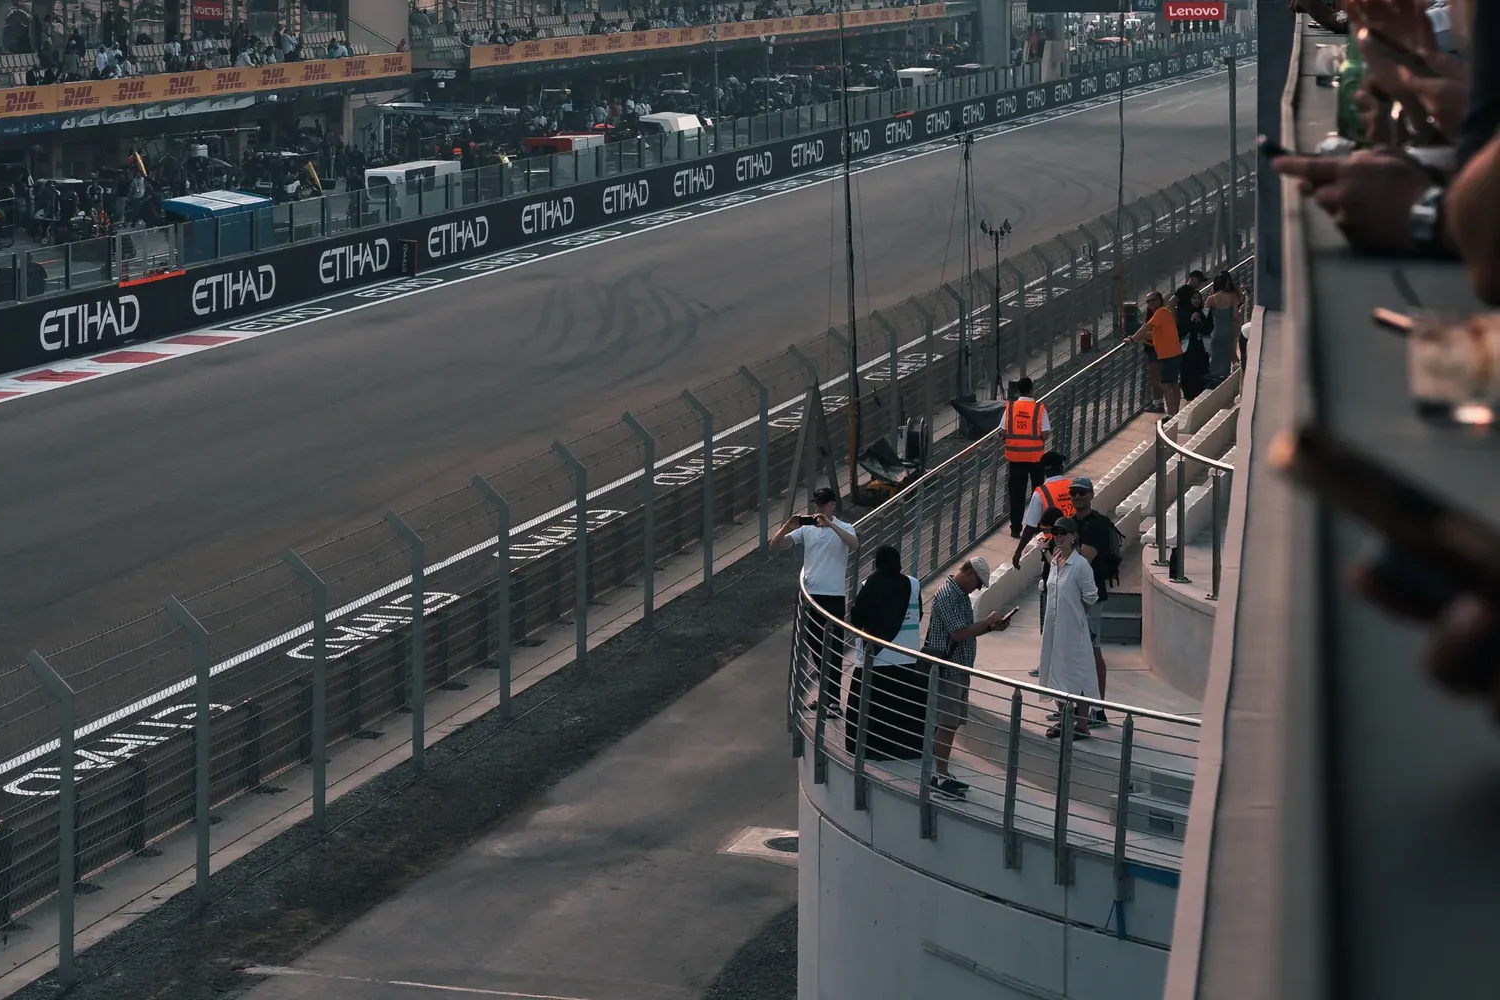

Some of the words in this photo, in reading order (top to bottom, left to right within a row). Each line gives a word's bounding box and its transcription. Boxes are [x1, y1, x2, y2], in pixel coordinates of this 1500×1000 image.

[1169, 5, 1219, 16] Lenovo
[305, 64, 327, 81] DHL
[346, 60, 367, 77] DHL
[384, 56, 403, 73] DHL
[432, 69, 457, 79] YAS
[170, 76, 197, 95] DHL
[218, 72, 242, 90] DHL
[263, 68, 285, 85] DHL
[1081, 76, 1098, 96] ETIHAD
[1105, 71, 1120, 90] ETIHAD
[64, 87, 95, 106] DHL
[119, 81, 145, 100] DHL
[1026, 88, 1046, 109] ETIHAD
[1054, 82, 1073, 102] ETIHAD
[6, 91, 36, 111] DHL
[996, 95, 1017, 117] ETIHAD
[926, 110, 950, 134] ETIHAD
[963, 102, 985, 126] ETIHAD
[885, 119, 912, 144] ETIHAD
[790, 138, 825, 168] ETIHAD
[735, 151, 772, 182] ETIHAD
[673, 164, 714, 197] ETIHAD
[603, 179, 649, 215] ETIHAD
[521, 196, 574, 235] ETIHAD
[428, 215, 488, 258] ETIHAD
[319, 238, 389, 284] ETIHAD
[192, 264, 276, 315] ETIHAD
[40, 294, 140, 351] ETIHAD
